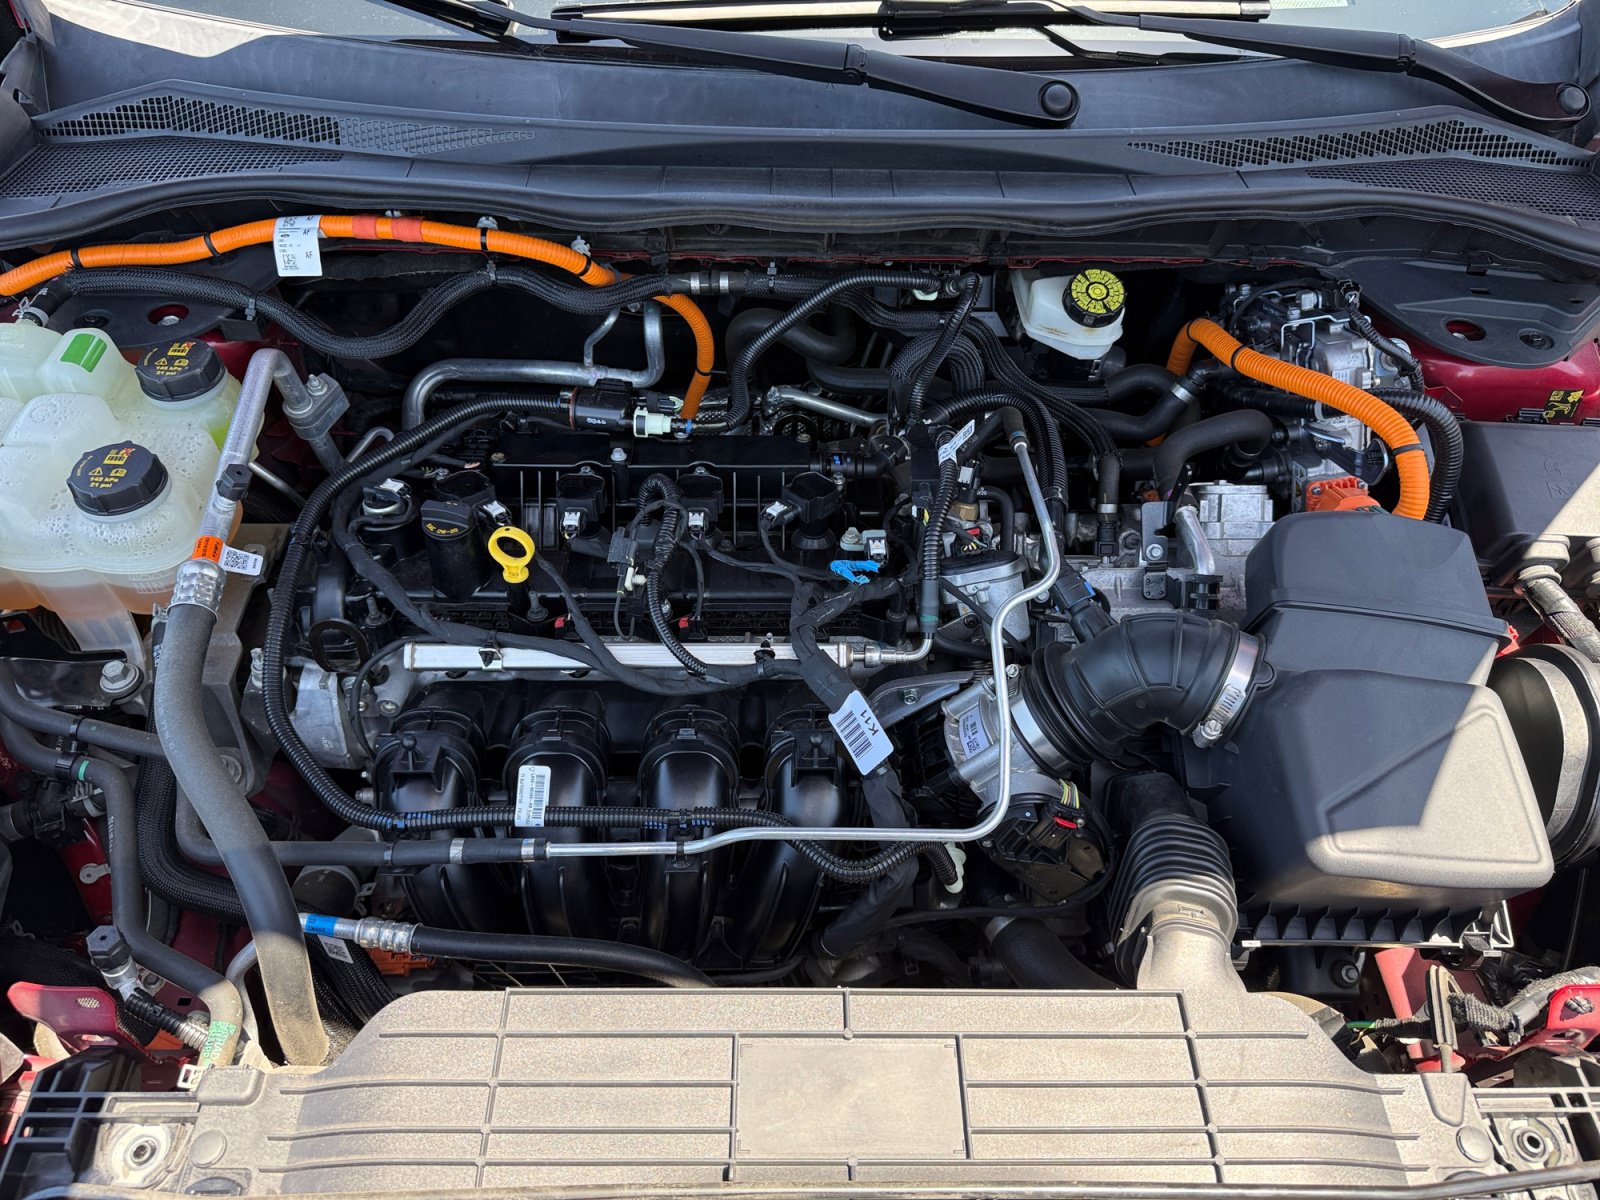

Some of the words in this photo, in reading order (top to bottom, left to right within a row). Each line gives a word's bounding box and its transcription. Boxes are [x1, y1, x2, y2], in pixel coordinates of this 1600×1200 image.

[303, 228, 310, 236] AF
[305, 251, 312, 259] AF
[425, 523, 436, 532] SAE
[860, 709, 879, 737] K11
